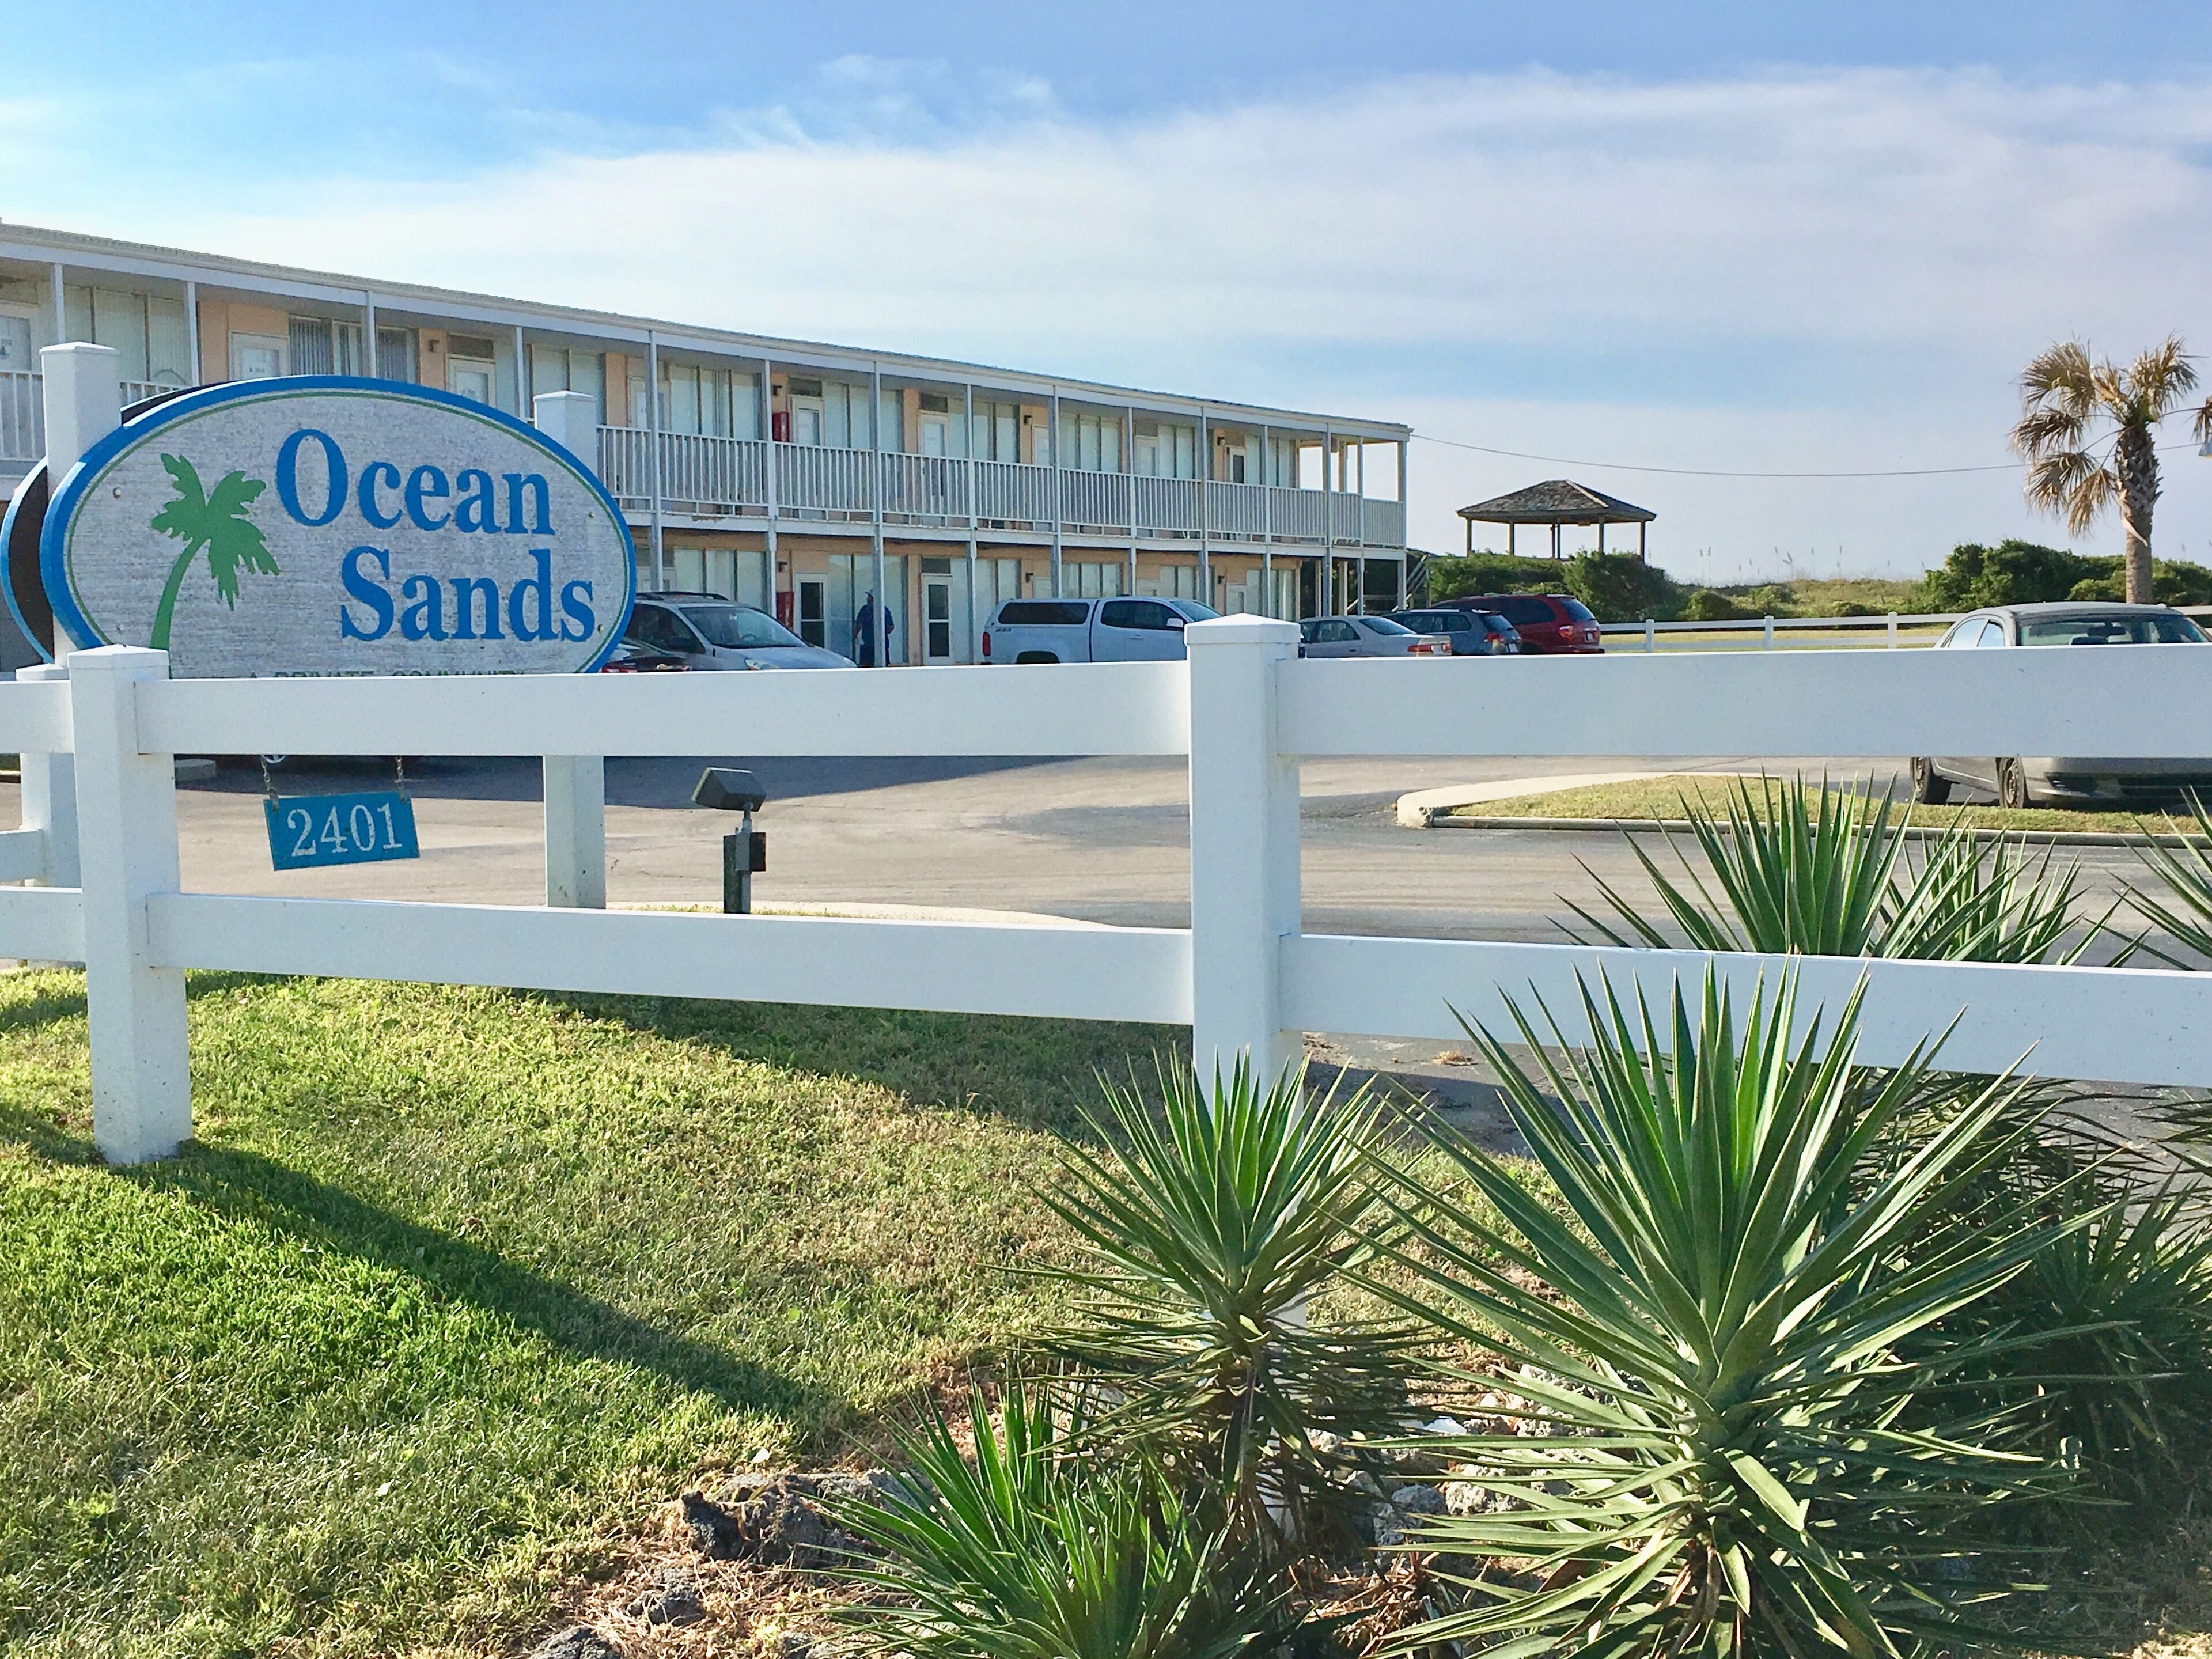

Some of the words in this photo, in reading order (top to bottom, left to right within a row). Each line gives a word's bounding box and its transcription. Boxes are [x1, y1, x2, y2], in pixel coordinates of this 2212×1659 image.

[276, 428, 556, 535] Ocean
[341, 545, 595, 642] Sands
[287, 802, 403, 857] 2401
